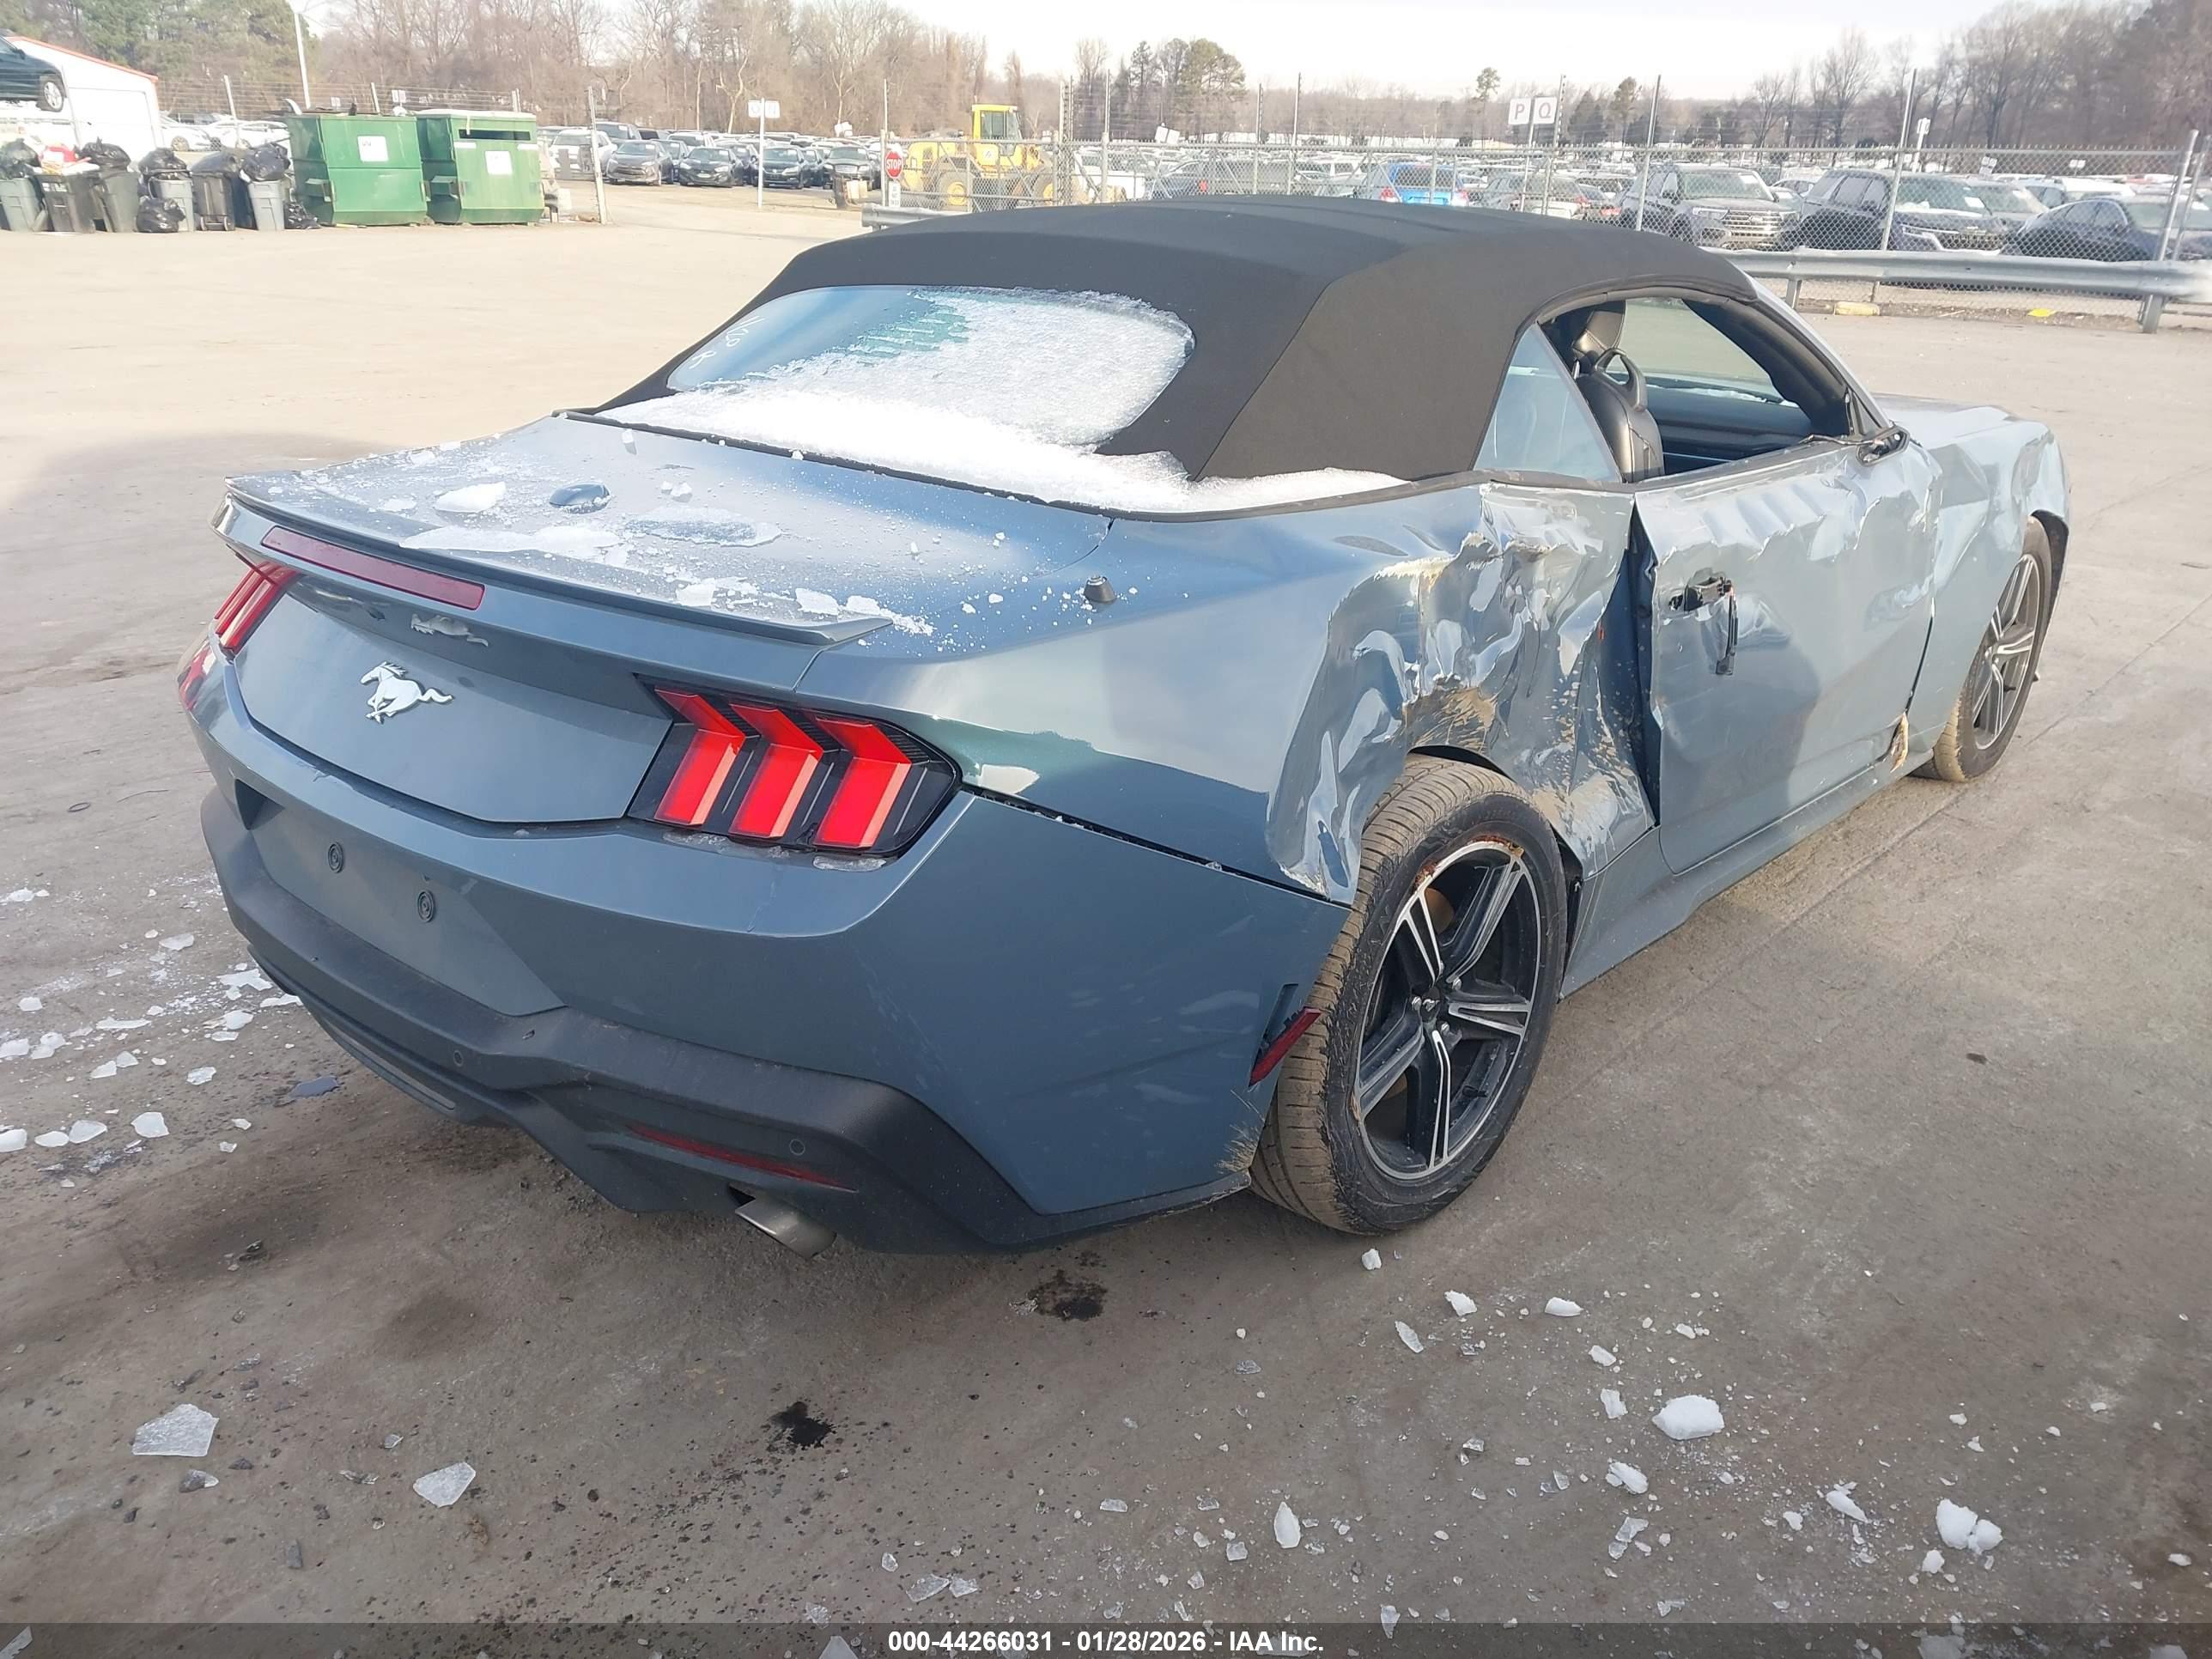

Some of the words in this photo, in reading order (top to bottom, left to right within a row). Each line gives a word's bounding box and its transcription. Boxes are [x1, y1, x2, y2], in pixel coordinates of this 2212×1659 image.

[1515, 103, 1525, 119] P
[1538, 102, 1551, 118] Q
[886, 159, 902, 170] STOP
